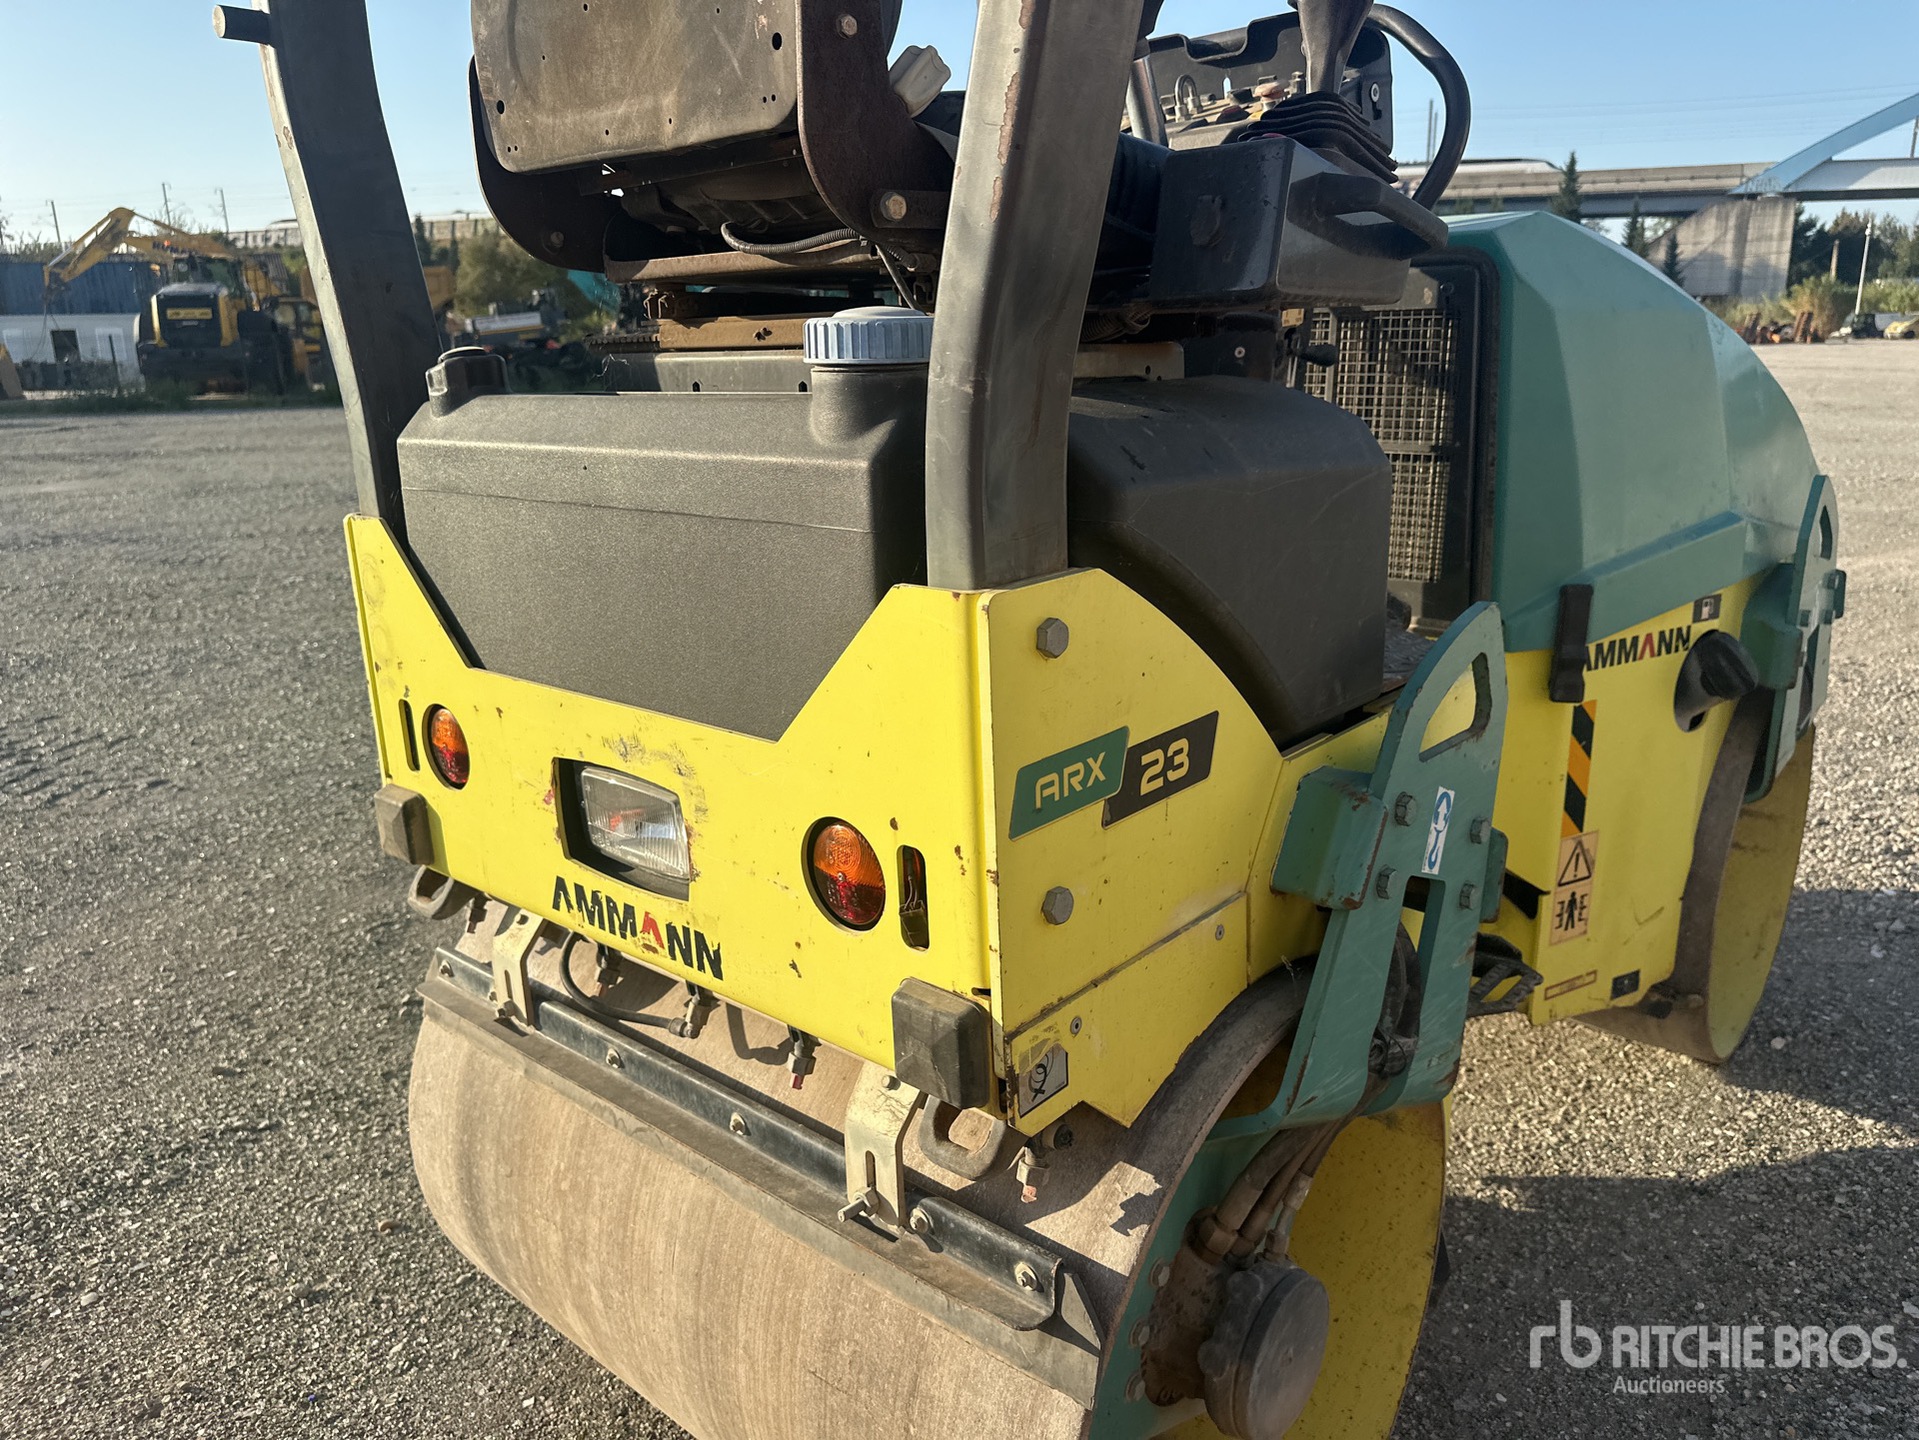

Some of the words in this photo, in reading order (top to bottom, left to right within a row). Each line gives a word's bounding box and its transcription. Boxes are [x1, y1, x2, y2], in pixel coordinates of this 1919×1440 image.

[1035, 751, 1107, 809] ARX
[1140, 737, 1190, 797] 23
[552, 875, 723, 981] AMMANN
